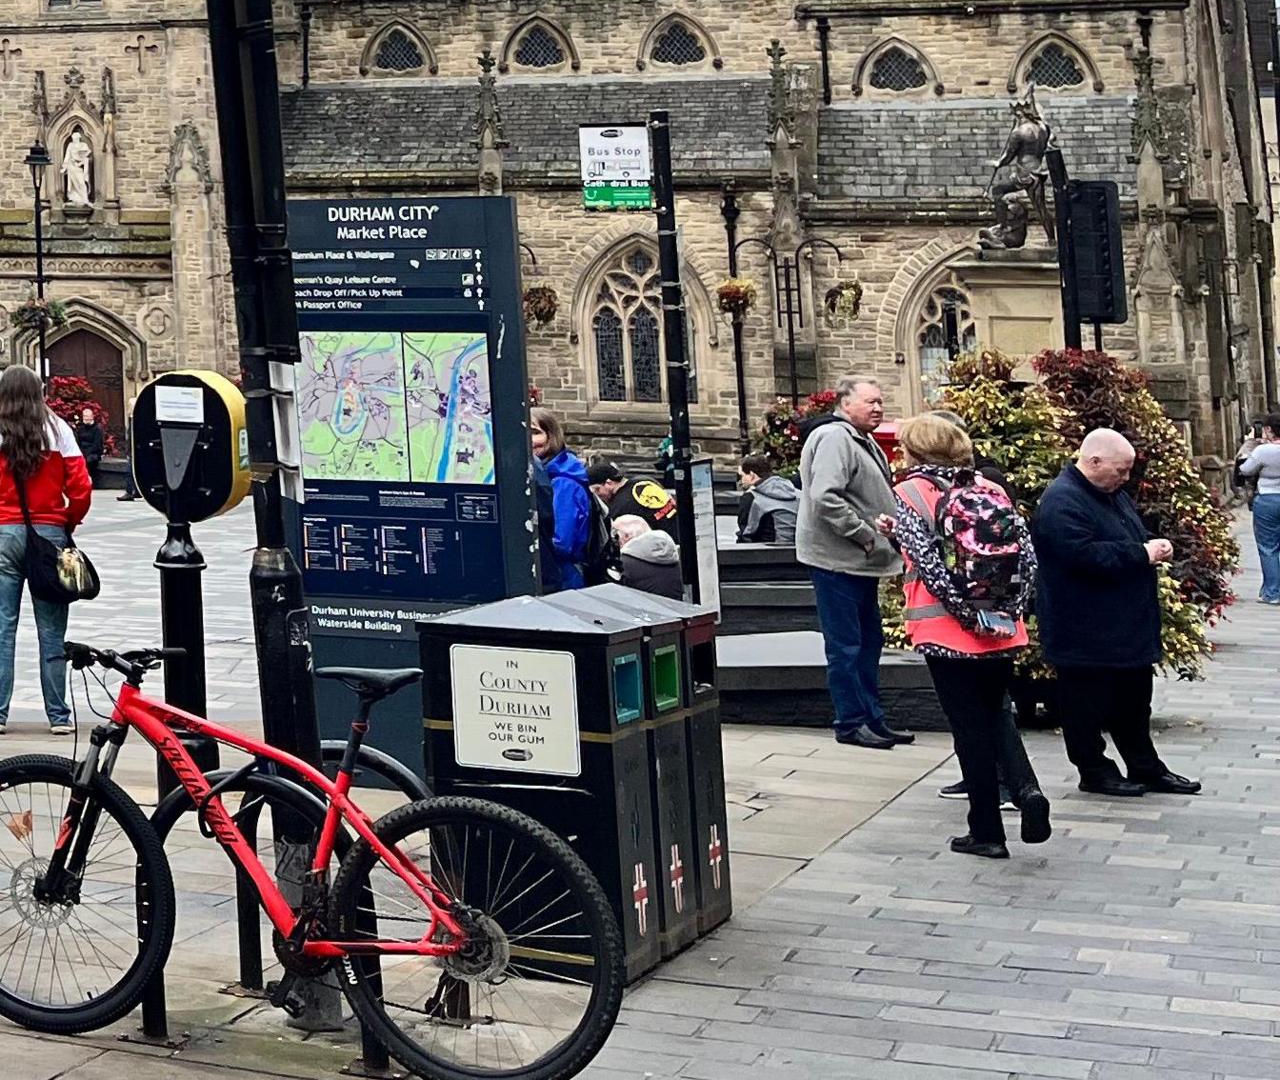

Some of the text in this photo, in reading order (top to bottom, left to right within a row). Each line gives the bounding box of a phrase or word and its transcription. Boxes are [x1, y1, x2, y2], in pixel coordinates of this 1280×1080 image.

[588, 147, 641, 157] Bus Stop
[328, 206, 434, 222] DURHAM CITY
[337, 226, 428, 240] Market Place
[324, 276, 343, 285] Quay
[345, 276, 371, 284] Leisure
[372, 275, 397, 284] Centre
[313, 289, 332, 298] Drop
[368, 289, 380, 298] Up
[382, 289, 403, 297] Point
[303, 301, 336, 310] Passport
[337, 300, 362, 309] Office
[312, 605, 348, 616] Durham
[350, 608, 394, 619] University
[318, 618, 402, 633] Waterside Building
[506, 660, 518, 669] IN
[480, 671, 548, 692] COUNTY
[480, 695, 551, 716] DURHAM
[495, 722, 537, 733] WE BIN
[488, 732, 544, 744] OUR GUM
